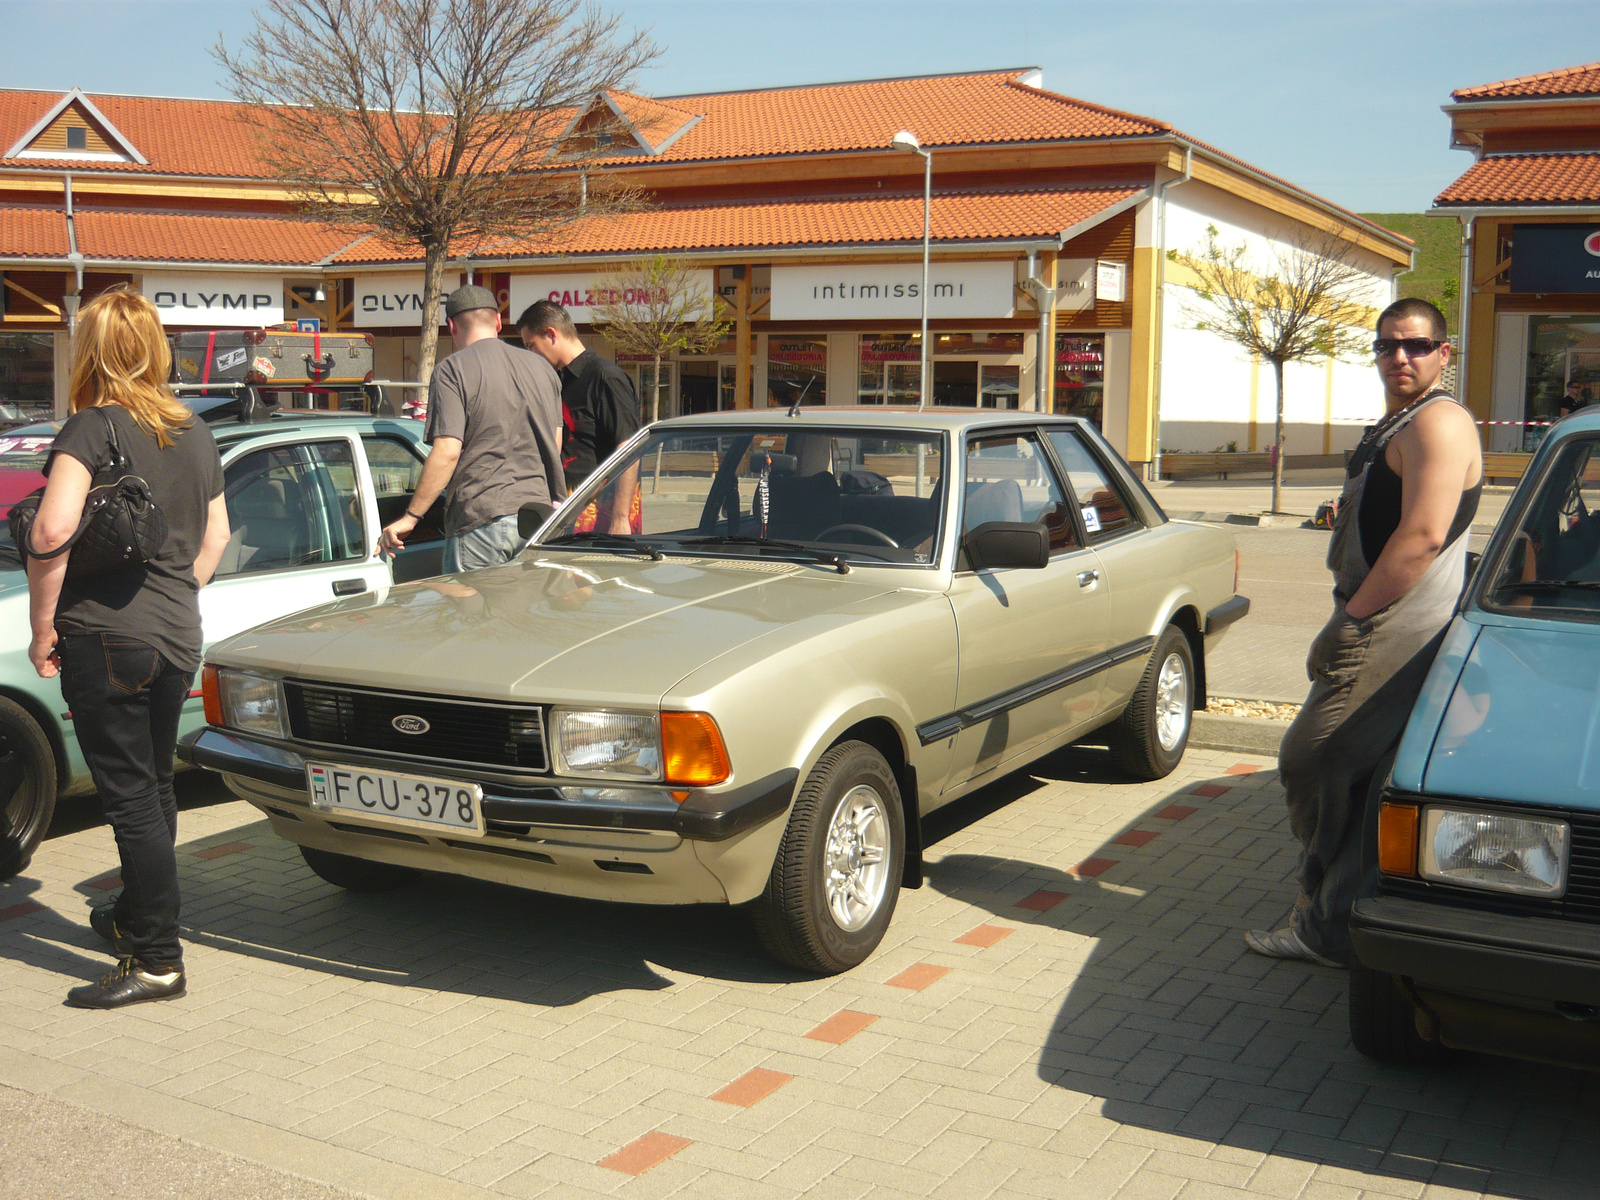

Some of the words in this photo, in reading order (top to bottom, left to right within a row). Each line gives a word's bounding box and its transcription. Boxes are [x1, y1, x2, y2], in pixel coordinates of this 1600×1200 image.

[548, 288, 670, 307] CALZEDONIA
[813, 282, 963, 299] intimissmi
[155, 291, 272, 310] OLYMP
[400, 718, 421, 731] Ford
[313, 785, 327, 800] H
[333, 771, 474, 823] FCU-378
